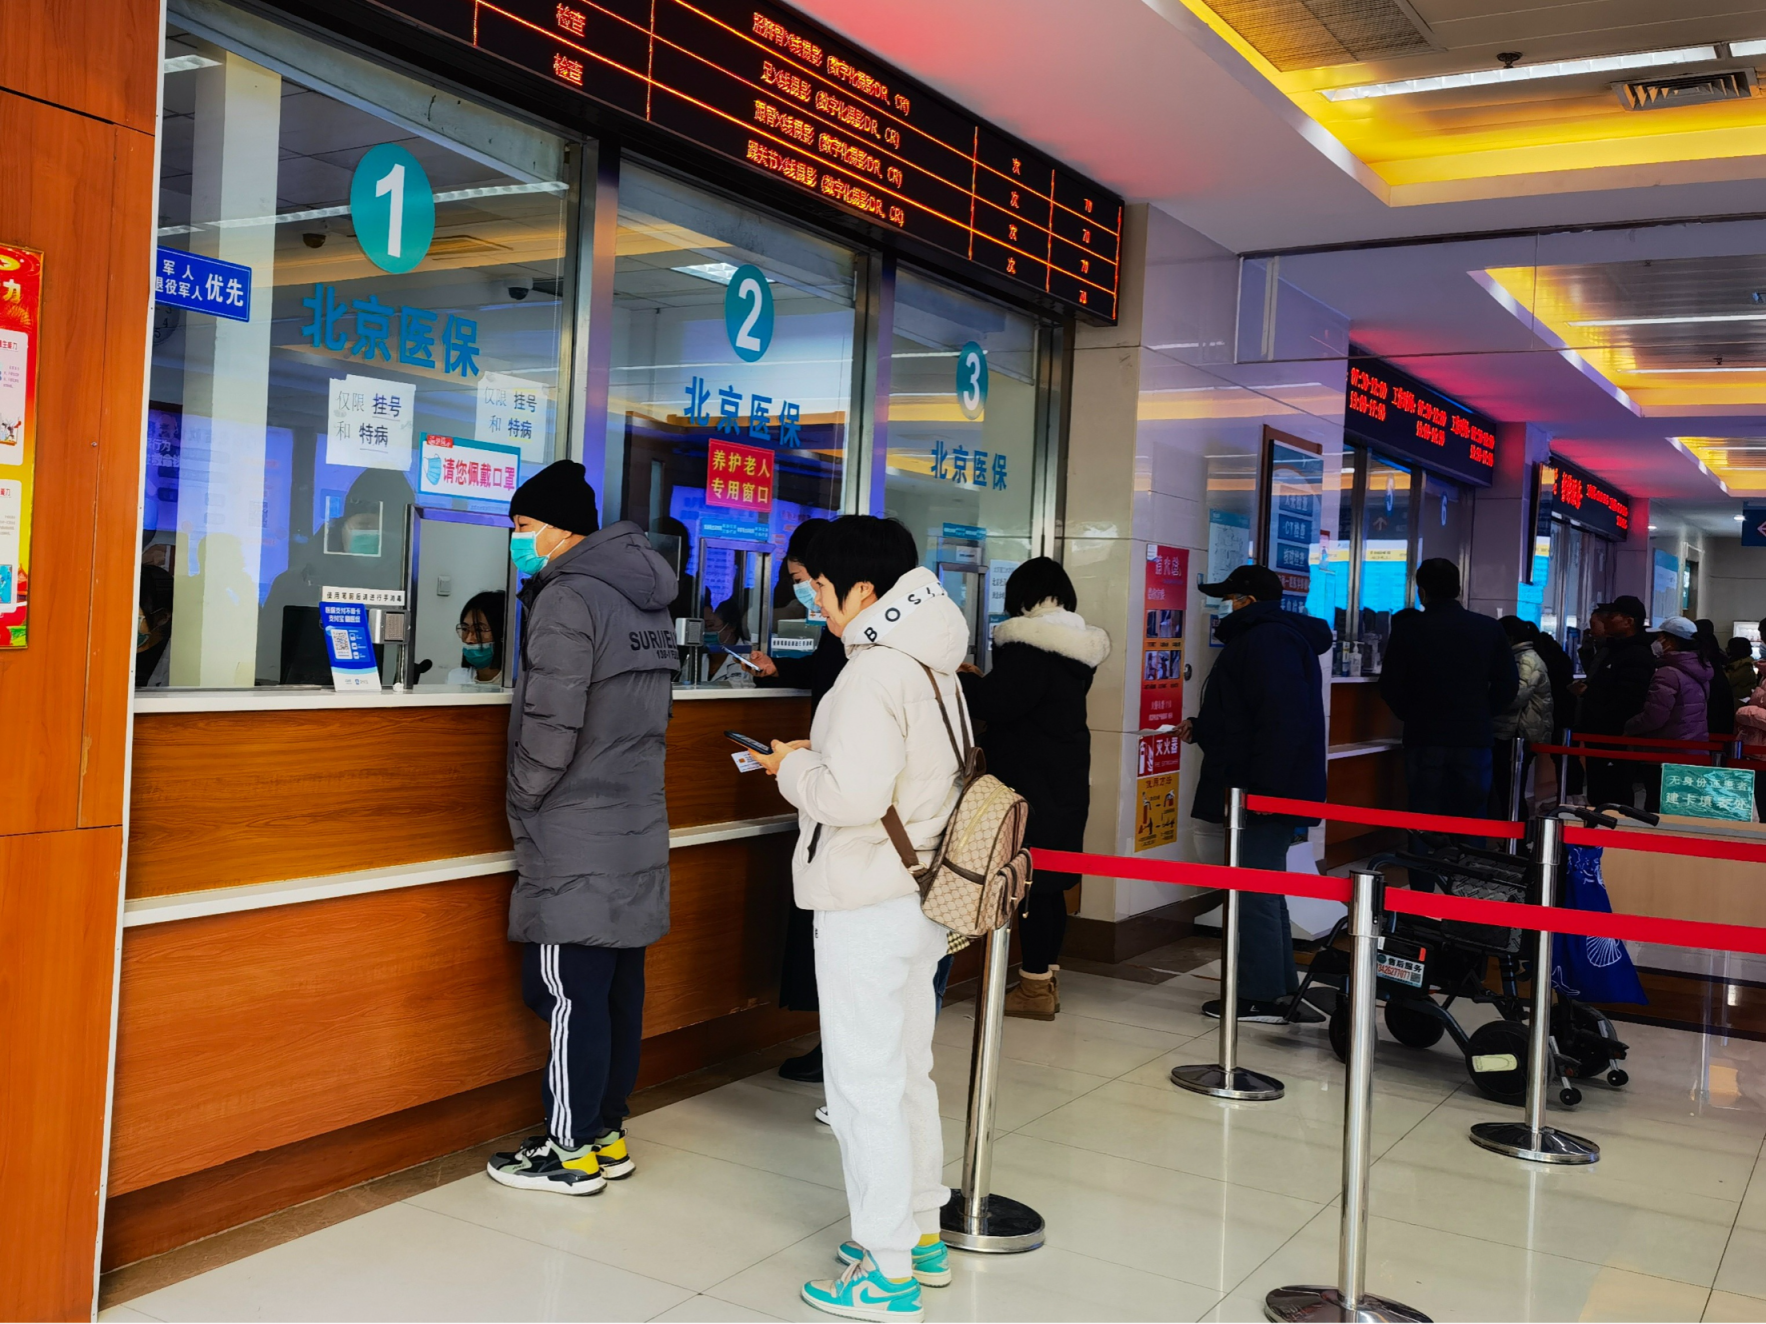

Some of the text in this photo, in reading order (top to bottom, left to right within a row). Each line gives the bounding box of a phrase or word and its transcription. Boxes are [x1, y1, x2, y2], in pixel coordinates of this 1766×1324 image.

[556, 2, 587, 38] 检查
[1008, 224, 1018, 241] 次
[553, 52, 584, 86] 检查
[1006, 257, 1016, 275] 次
[1011, 157, 1022, 176] 次
[376, 163, 405, 258] 1
[1009, 191, 1020, 208] 次
[162, 259, 194, 280] 军人
[205, 273, 244, 307] 优先
[302, 282, 481, 377] 北京医保
[735, 278, 763, 352] 2
[962, 352, 981, 411] 3
[336, 390, 402, 418] 仅限 挂号
[484, 386, 538, 413] 仅限 挂号
[683, 375, 802, 449] 北京医保
[336, 420, 389, 447] 和 特病
[488, 414, 533, 440] 和 特病
[442, 457, 516, 491] 请您佩戴口罩
[712, 449, 771, 479] 养护老人
[930, 440, 1008, 491] 北京医保
[711, 477, 769, 504] 专用窗口
[1666, 792, 1751, 811] 建卡填表处
